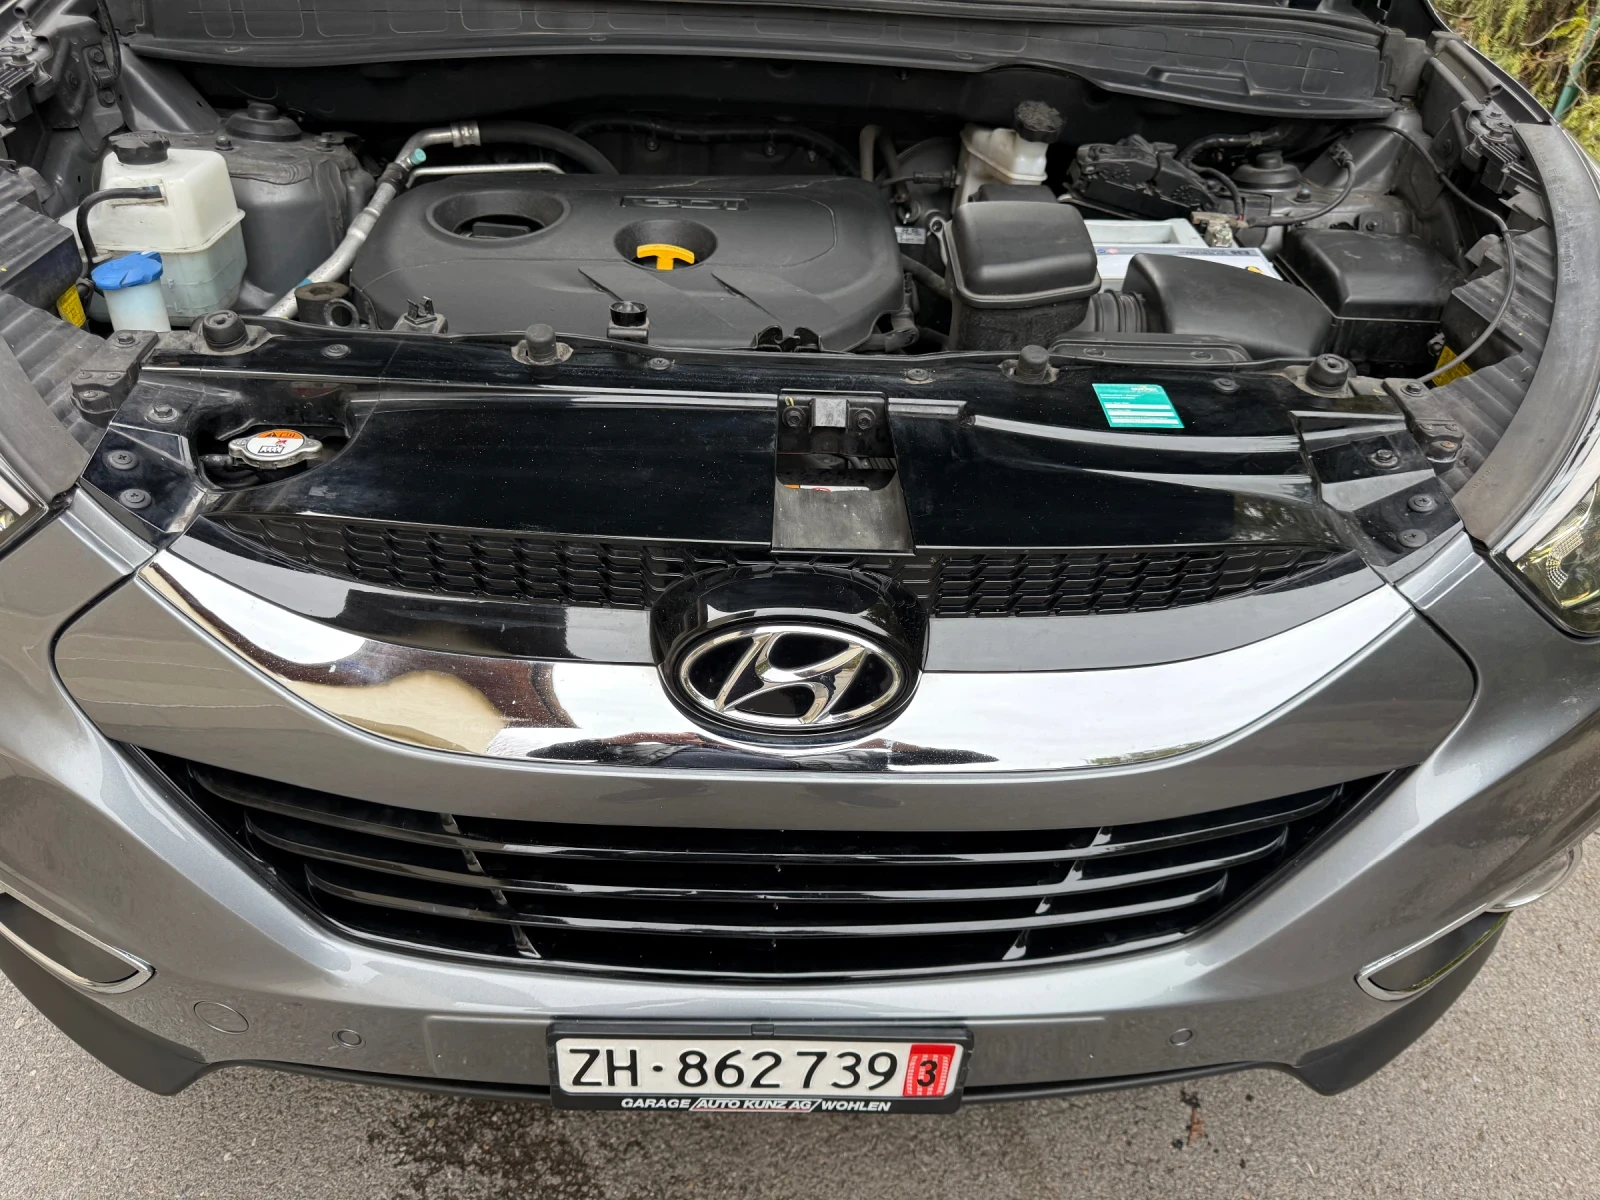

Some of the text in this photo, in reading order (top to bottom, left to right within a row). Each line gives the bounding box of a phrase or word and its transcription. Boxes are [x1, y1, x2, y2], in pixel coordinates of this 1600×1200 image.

[917, 1060, 938, 1087] 3
[621, 1098, 891, 1112] GARAGE AUTO KUNZ AG WOHLEN
